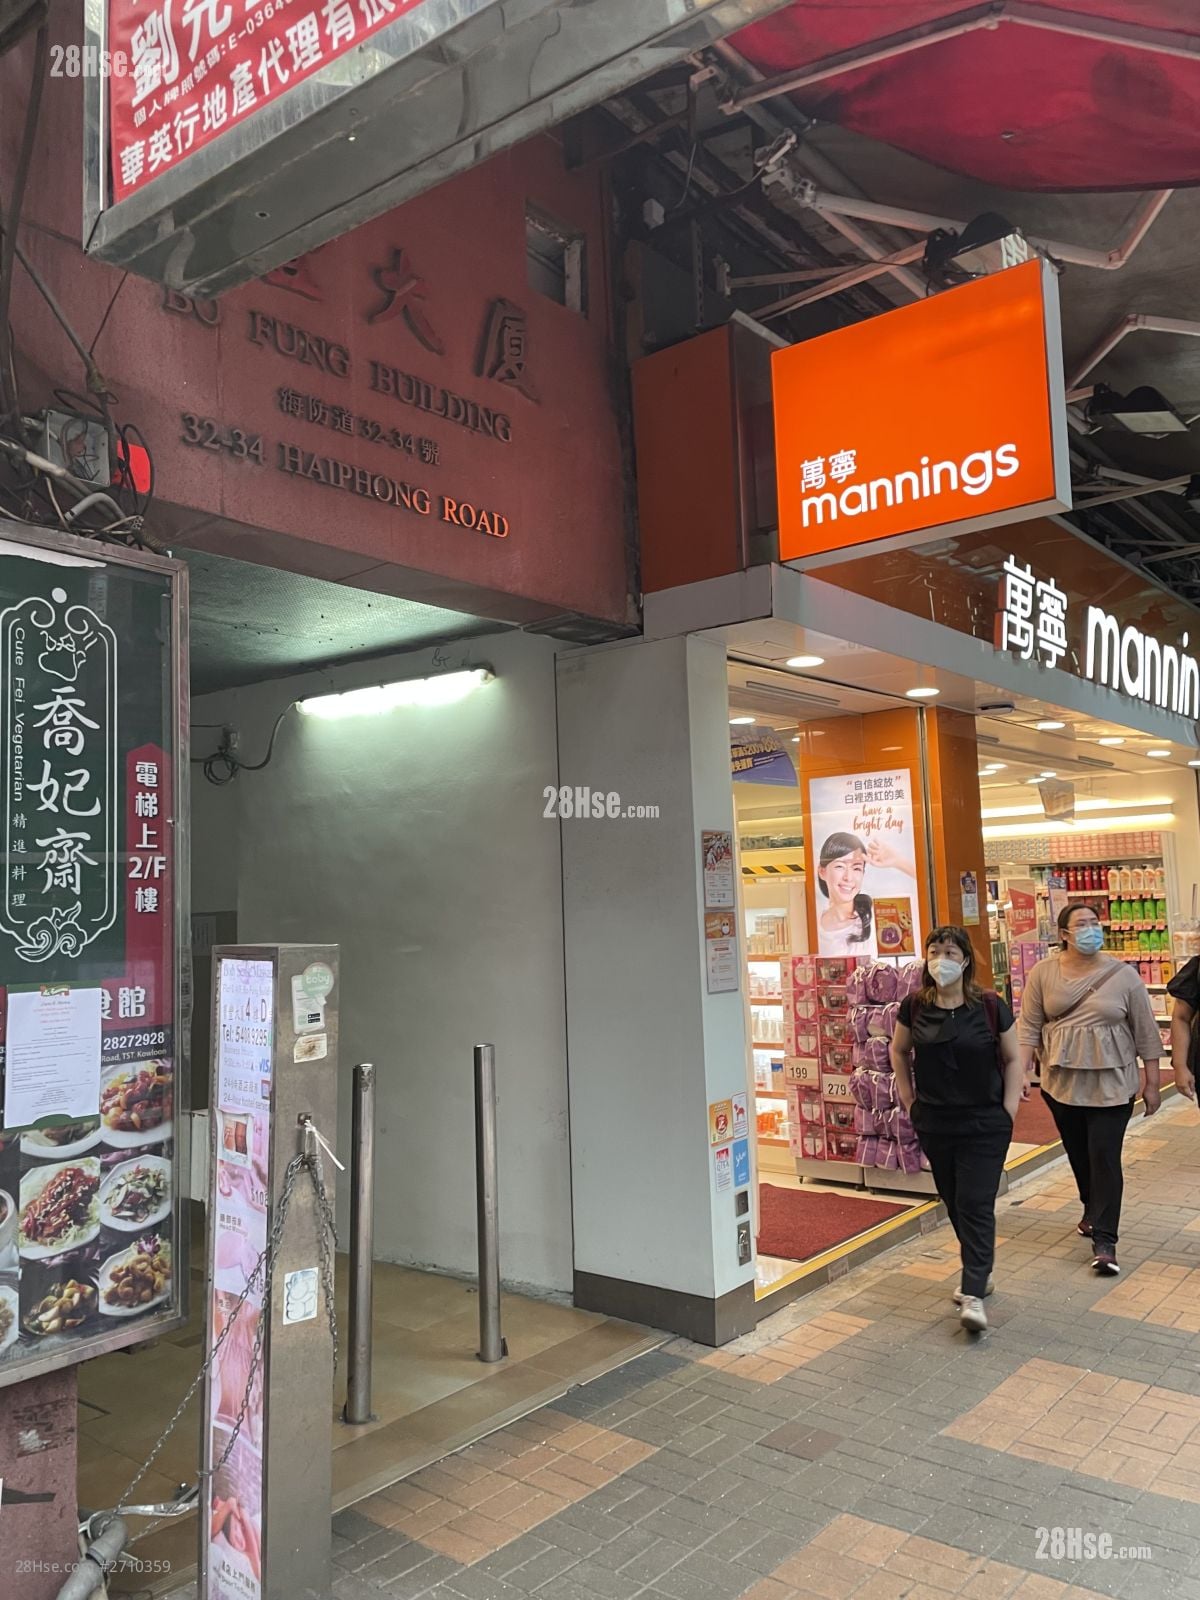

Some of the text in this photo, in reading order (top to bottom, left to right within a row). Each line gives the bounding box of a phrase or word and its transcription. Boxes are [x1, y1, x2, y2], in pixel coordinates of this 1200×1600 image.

[130, 0, 262, 107] 劉元
[134, 0, 294, 128] 個人牌照號碼:E-0364
[262, 246, 541, 404] 大廈
[248, 310, 350, 378] FUNG
[368, 359, 513, 443] BUILDING
[181, 411, 511, 538] 32-34 HAIPHONG ROAD
[800, 449, 857, 493] 萬寧
[802, 443, 1019, 527] mannings
[1002, 554, 1068, 669] 萬寧
[1086, 605, 1200, 720] mannin
[12, 627, 25, 802] Cute Fei Vegetarian
[12, 813, 27, 907] 精進料理
[854, 815, 903, 836] bright day
[863, 804, 882, 816] have
[103, 1031, 165, 1051] 28272928
[789, 1066, 808, 1079] 199
[828, 1083, 847, 1096] 279
